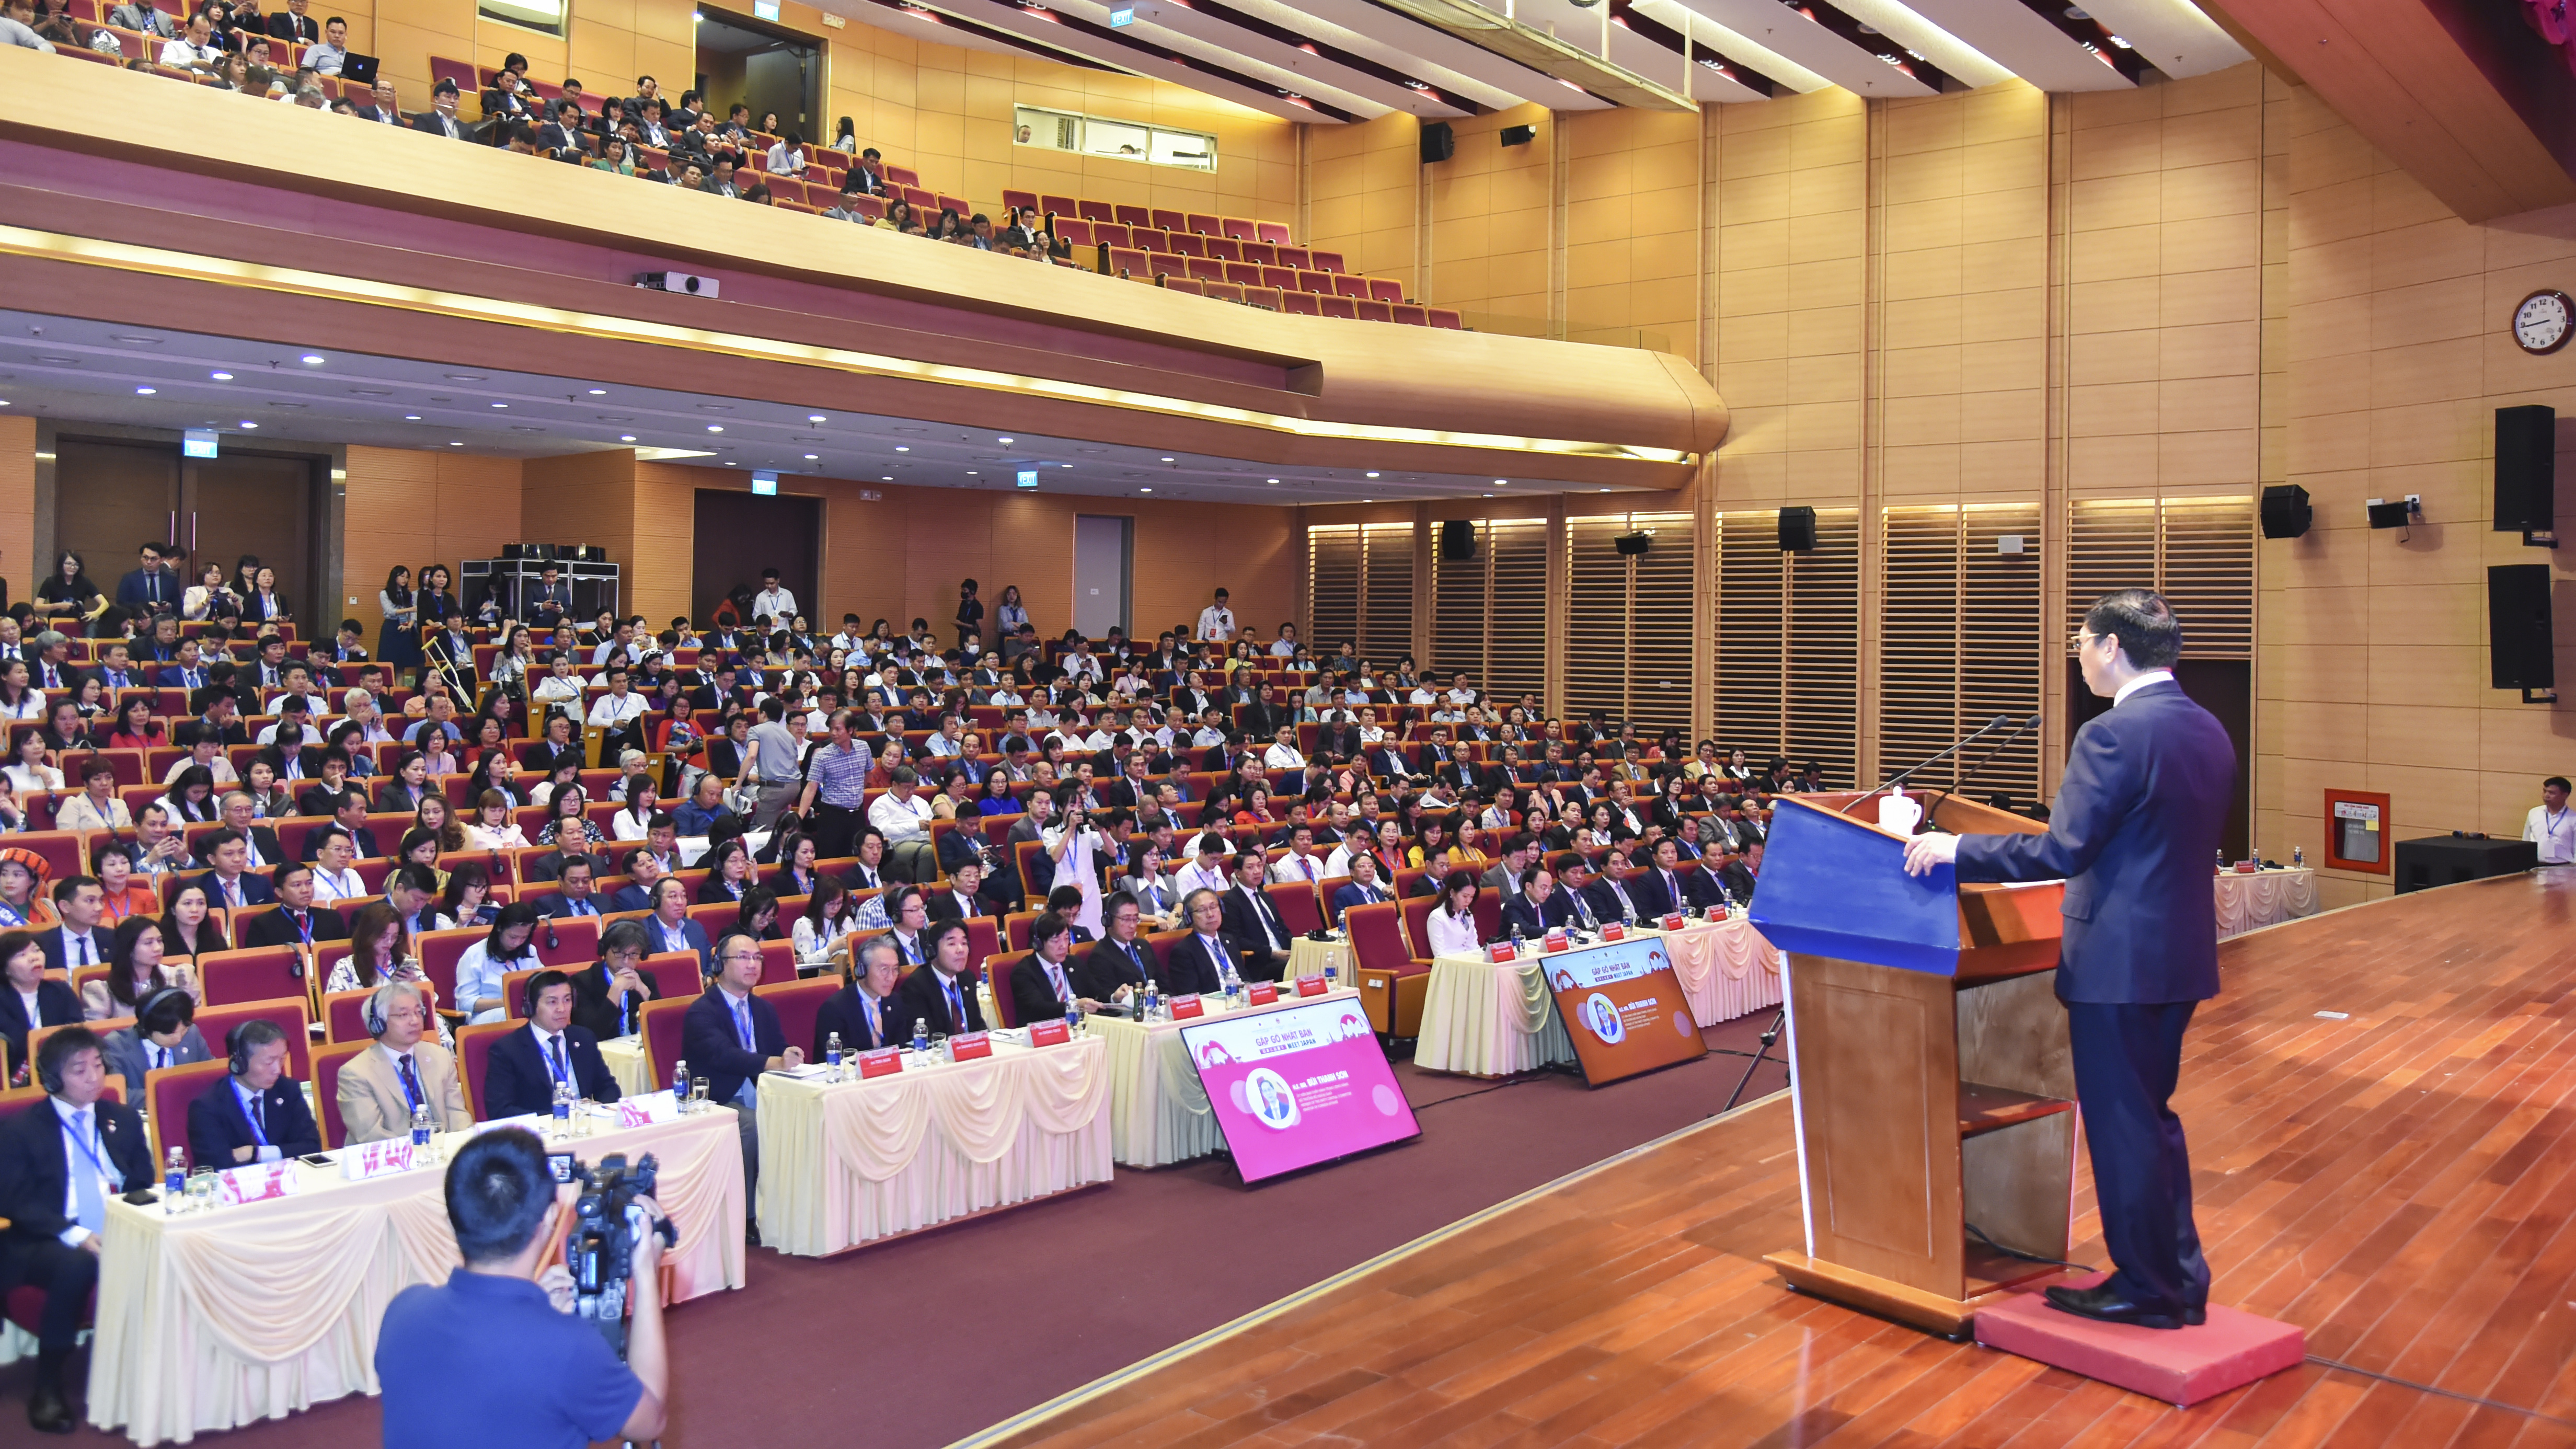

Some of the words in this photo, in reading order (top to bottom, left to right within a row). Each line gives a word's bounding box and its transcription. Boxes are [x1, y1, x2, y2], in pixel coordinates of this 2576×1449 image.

[1117, 12, 1131, 24] EXIT
[190, 443, 212, 454] EXIT
[1022, 474, 1036, 484] EXIT
[756, 481, 772, 492] EXIT
[1302, 1038, 1316, 1046] JAPAN
